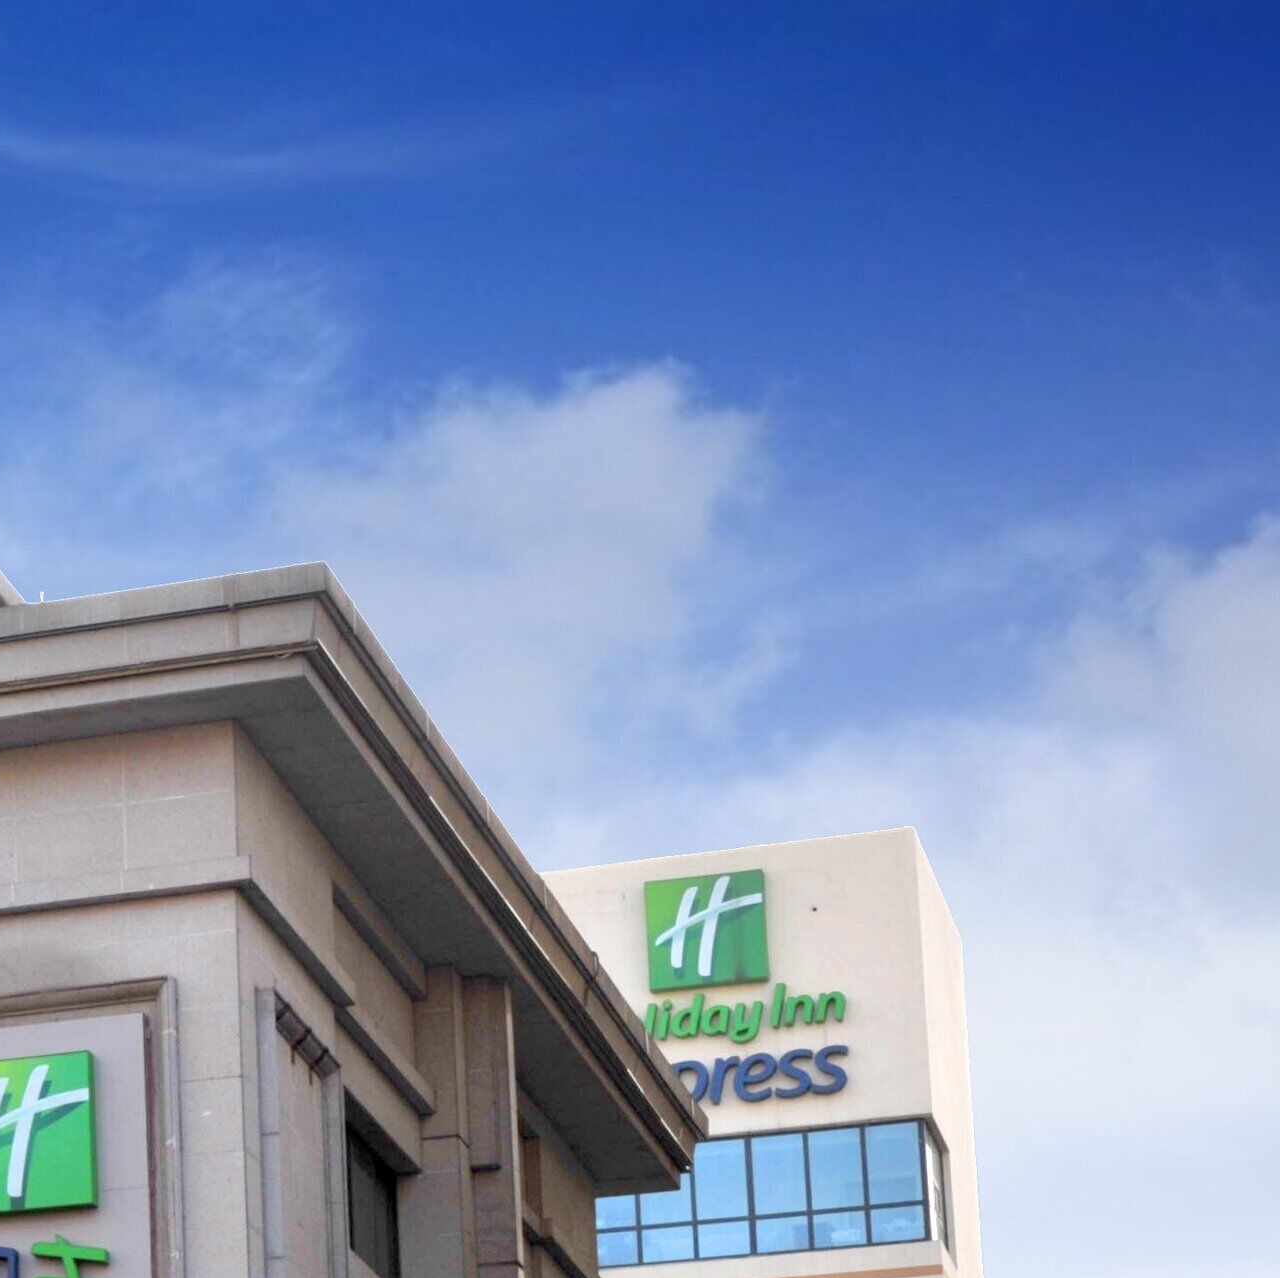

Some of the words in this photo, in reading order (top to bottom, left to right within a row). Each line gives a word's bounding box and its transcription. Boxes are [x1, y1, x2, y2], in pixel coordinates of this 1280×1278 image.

[645, 991, 763, 1044] liday
[770, 982, 846, 1029] Inn
[670, 1044, 849, 1106] press
